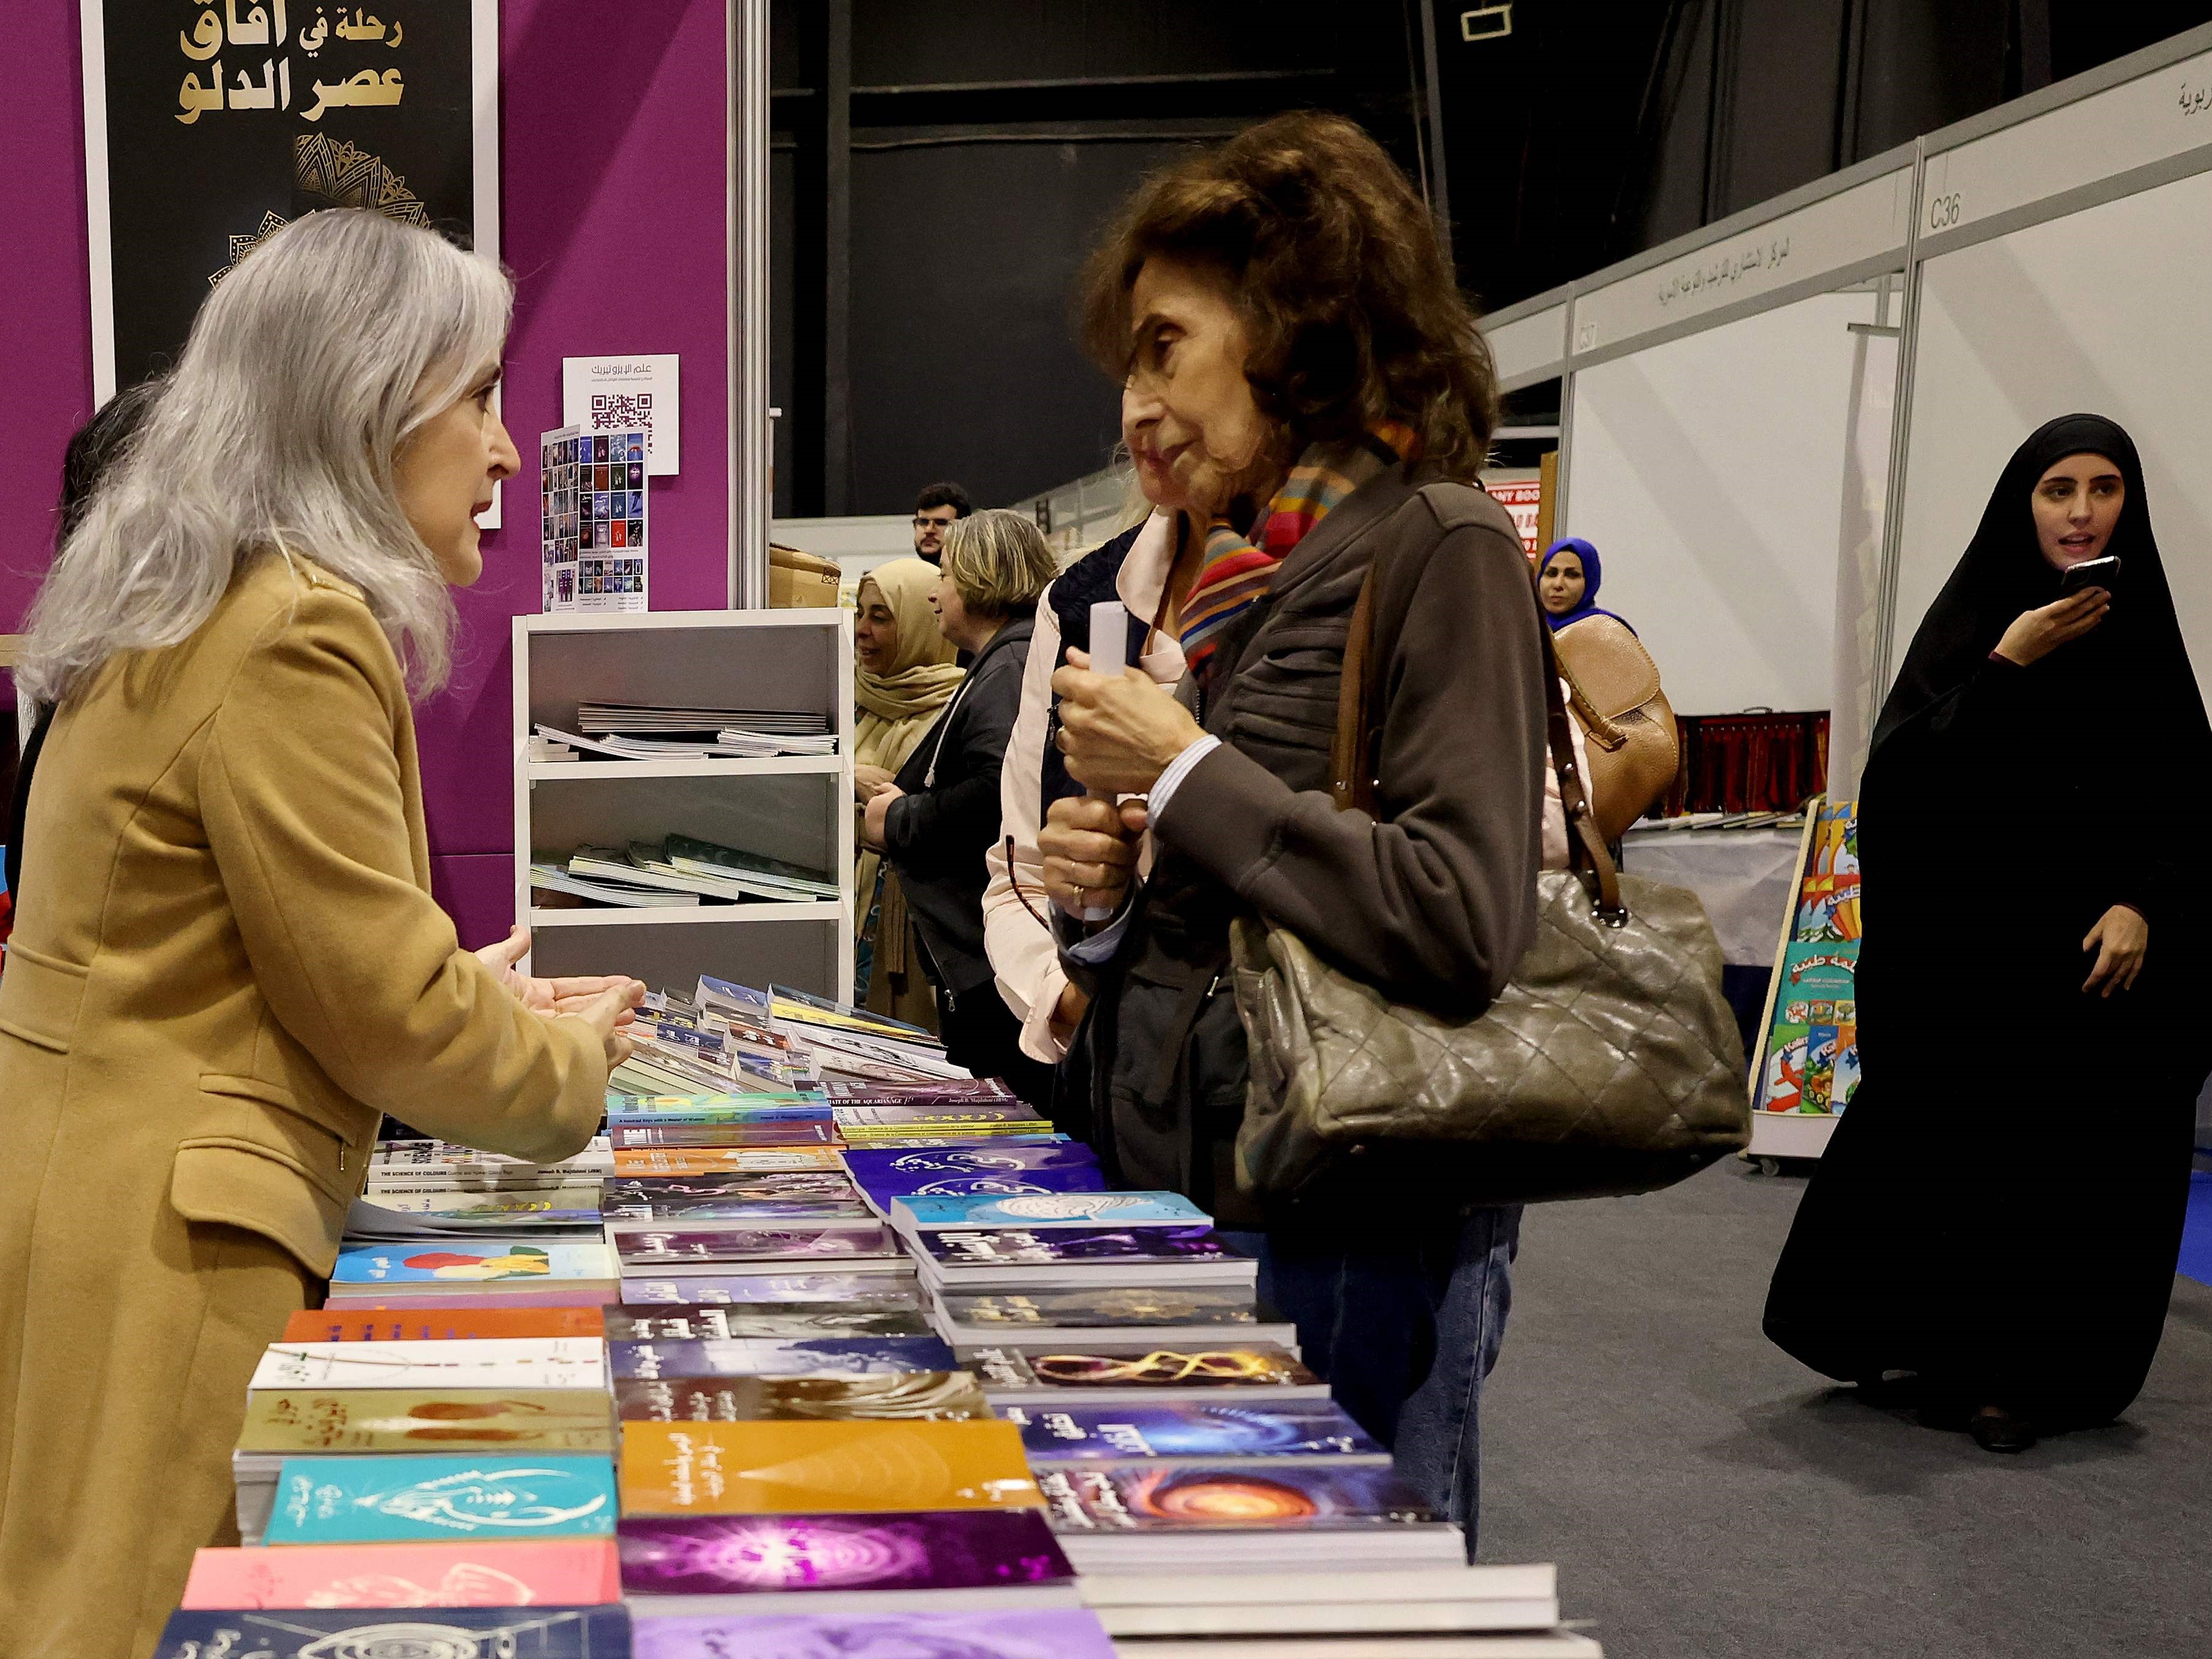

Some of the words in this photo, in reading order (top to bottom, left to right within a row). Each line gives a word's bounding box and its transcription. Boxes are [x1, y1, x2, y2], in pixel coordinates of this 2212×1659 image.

[299, 6, 328, 58] في
[335, 7, 403, 48] رحلة
[174, 56, 291, 125] الدلو
[299, 68, 404, 121] عصر
[1932, 193, 1961, 228] C36
[633, 363, 651, 374] علم
